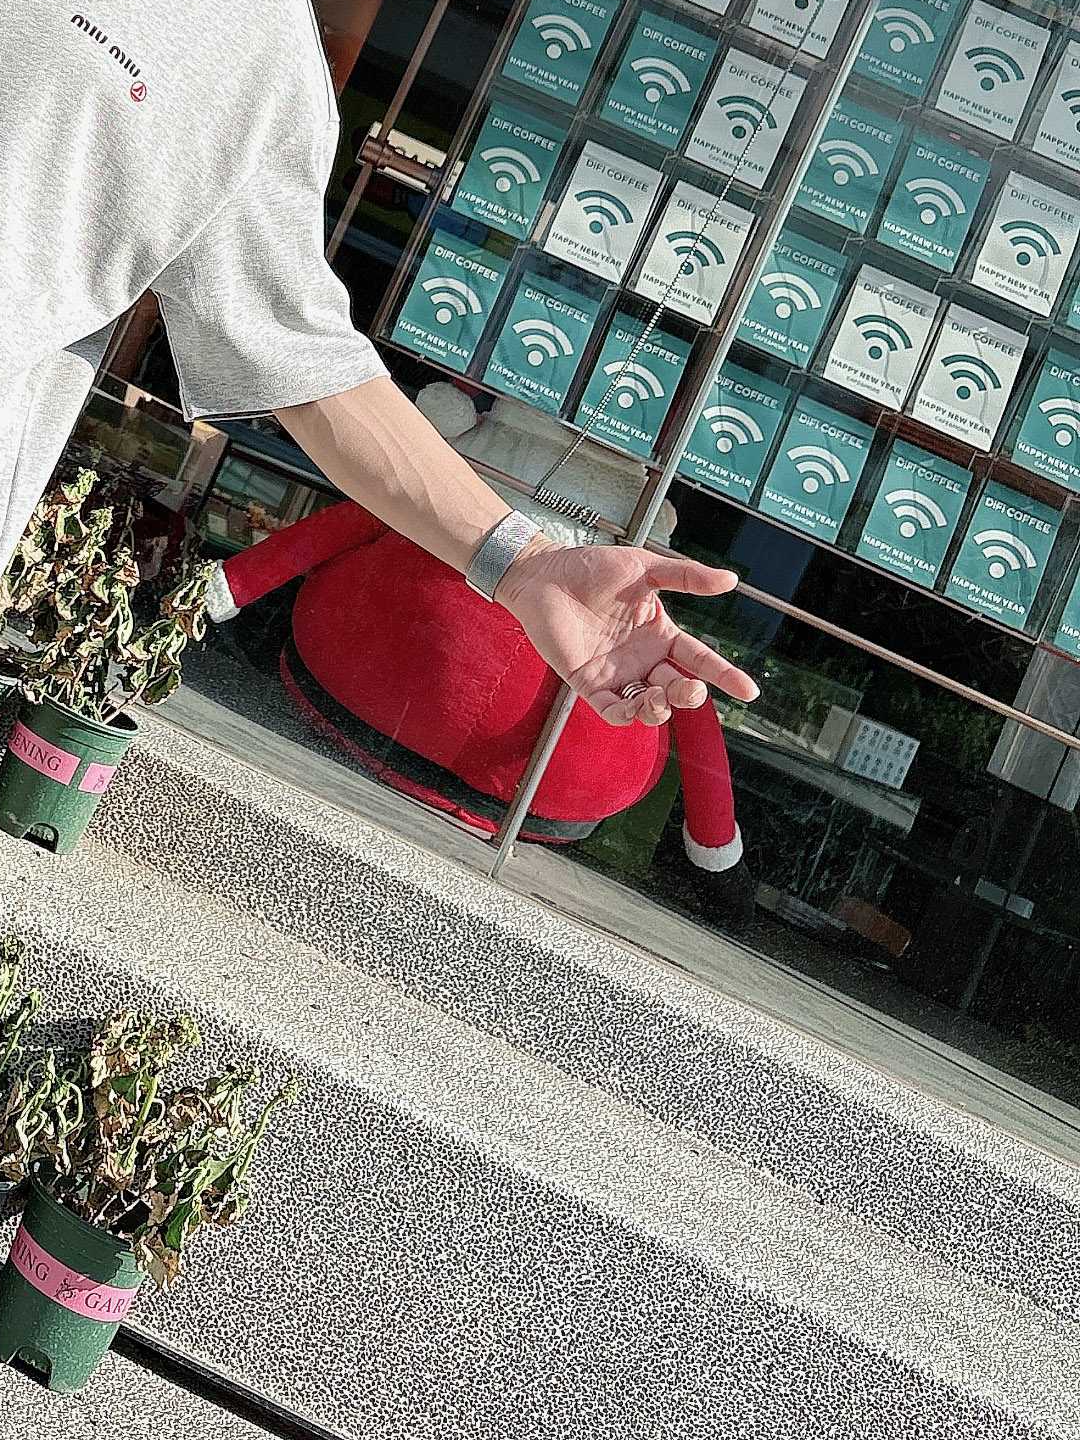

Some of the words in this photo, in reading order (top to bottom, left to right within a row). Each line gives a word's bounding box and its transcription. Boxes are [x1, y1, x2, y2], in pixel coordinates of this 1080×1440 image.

[71, 14, 108, 44] miu
[109, 45, 141, 78] miu
[509, 55, 537, 73] HAPPY
[537, 67, 557, 81] NEW
[557, 76, 580, 91] YEAR
[607, 99, 636, 116] HAPPY
[636, 111, 656, 125] NEW
[656, 119, 679, 135] YEAR
[942, 89, 970, 105] HAPPY
[971, 101, 991, 115] NEW
[991, 110, 1014, 124] YEAR
[692, 136, 721, 153] HAPPY
[606, 167, 649, 193] COFFEE
[936, 155, 981, 182] COFFEE
[458, 189, 486, 207] HAPPY
[487, 201, 507, 215] NEW
[506, 209, 529, 225] YEAR
[824, 194, 844, 208] NEW
[844, 202, 868, 218] YEAR
[1031, 197, 1075, 223] COFFEE
[551, 231, 579, 248] HAPPY
[579, 244, 599, 258] NEW
[599, 253, 622, 268] YEAR
[883, 220, 911, 238] HAPPY
[911, 233, 932, 248] NEW
[931, 242, 955, 258] YEAR
[978, 263, 1006, 281] HAPPY
[1007, 276, 1028, 290] NEW
[1028, 285, 1050, 300] YEAR
[398, 320, 426, 338] HAPPY
[426, 332, 446, 347] NEW
[446, 341, 469, 358] YEAR
[635, 338, 680, 365] OFFEE
[766, 327, 786, 342] NEW
[786, 336, 810, 353] YEAR
[972, 330, 1016, 357] COFFEE
[830, 357, 858, 375] HAPPY
[859, 370, 879, 384] NEW
[879, 380, 901, 395] YEAR
[918, 397, 946, 415] HAPPY
[947, 410, 968, 425] NEW
[968, 420, 990, 435] YEAR
[819, 422, 864, 449] COFFEE
[1017, 442, 1046, 461] HAPPY
[1047, 455, 1068, 470] NEW
[707, 461, 728, 476] NEW
[728, 470, 752, 487] YEAR
[916, 466, 961, 494] COFFEE
[765, 489, 794, 508] HAPPY
[794, 502, 814, 517] NEW
[814, 511, 838, 528] YEAR
[1005, 506, 1051, 534] COFFEE
[863, 534, 891, 553] HAPPY
[892, 547, 912, 562] NEW
[912, 556, 936, 573] YEAR
[951, 575, 980, 594] HAPPY
[981, 588, 1002, 603] NEW
[1001, 597, 1025, 614] YEAR
